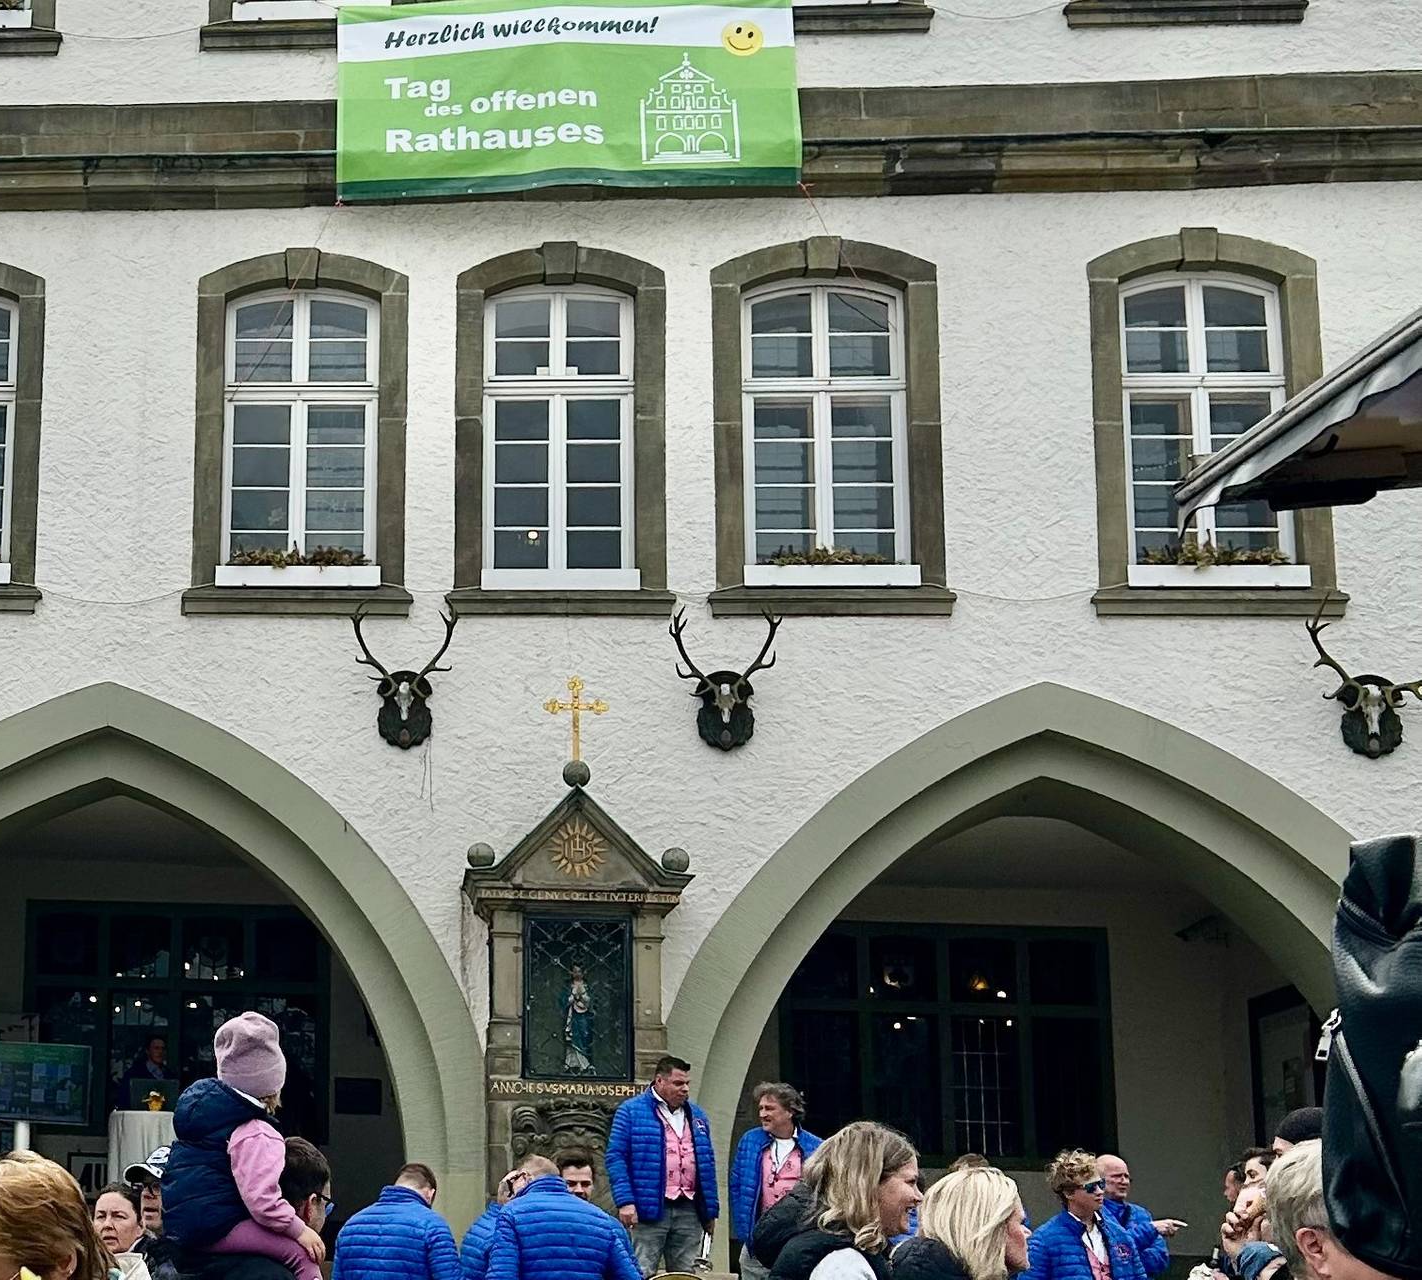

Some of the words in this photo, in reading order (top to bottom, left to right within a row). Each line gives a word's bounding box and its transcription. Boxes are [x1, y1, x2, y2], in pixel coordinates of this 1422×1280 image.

[384, 21, 485, 49] Herzlich
[493, 16, 660, 38] willkommen!
[384, 77, 451, 102] Tag
[424, 102, 463, 118] des
[470, 86, 598, 115] offenen
[385, 122, 605, 154] Rathauses
